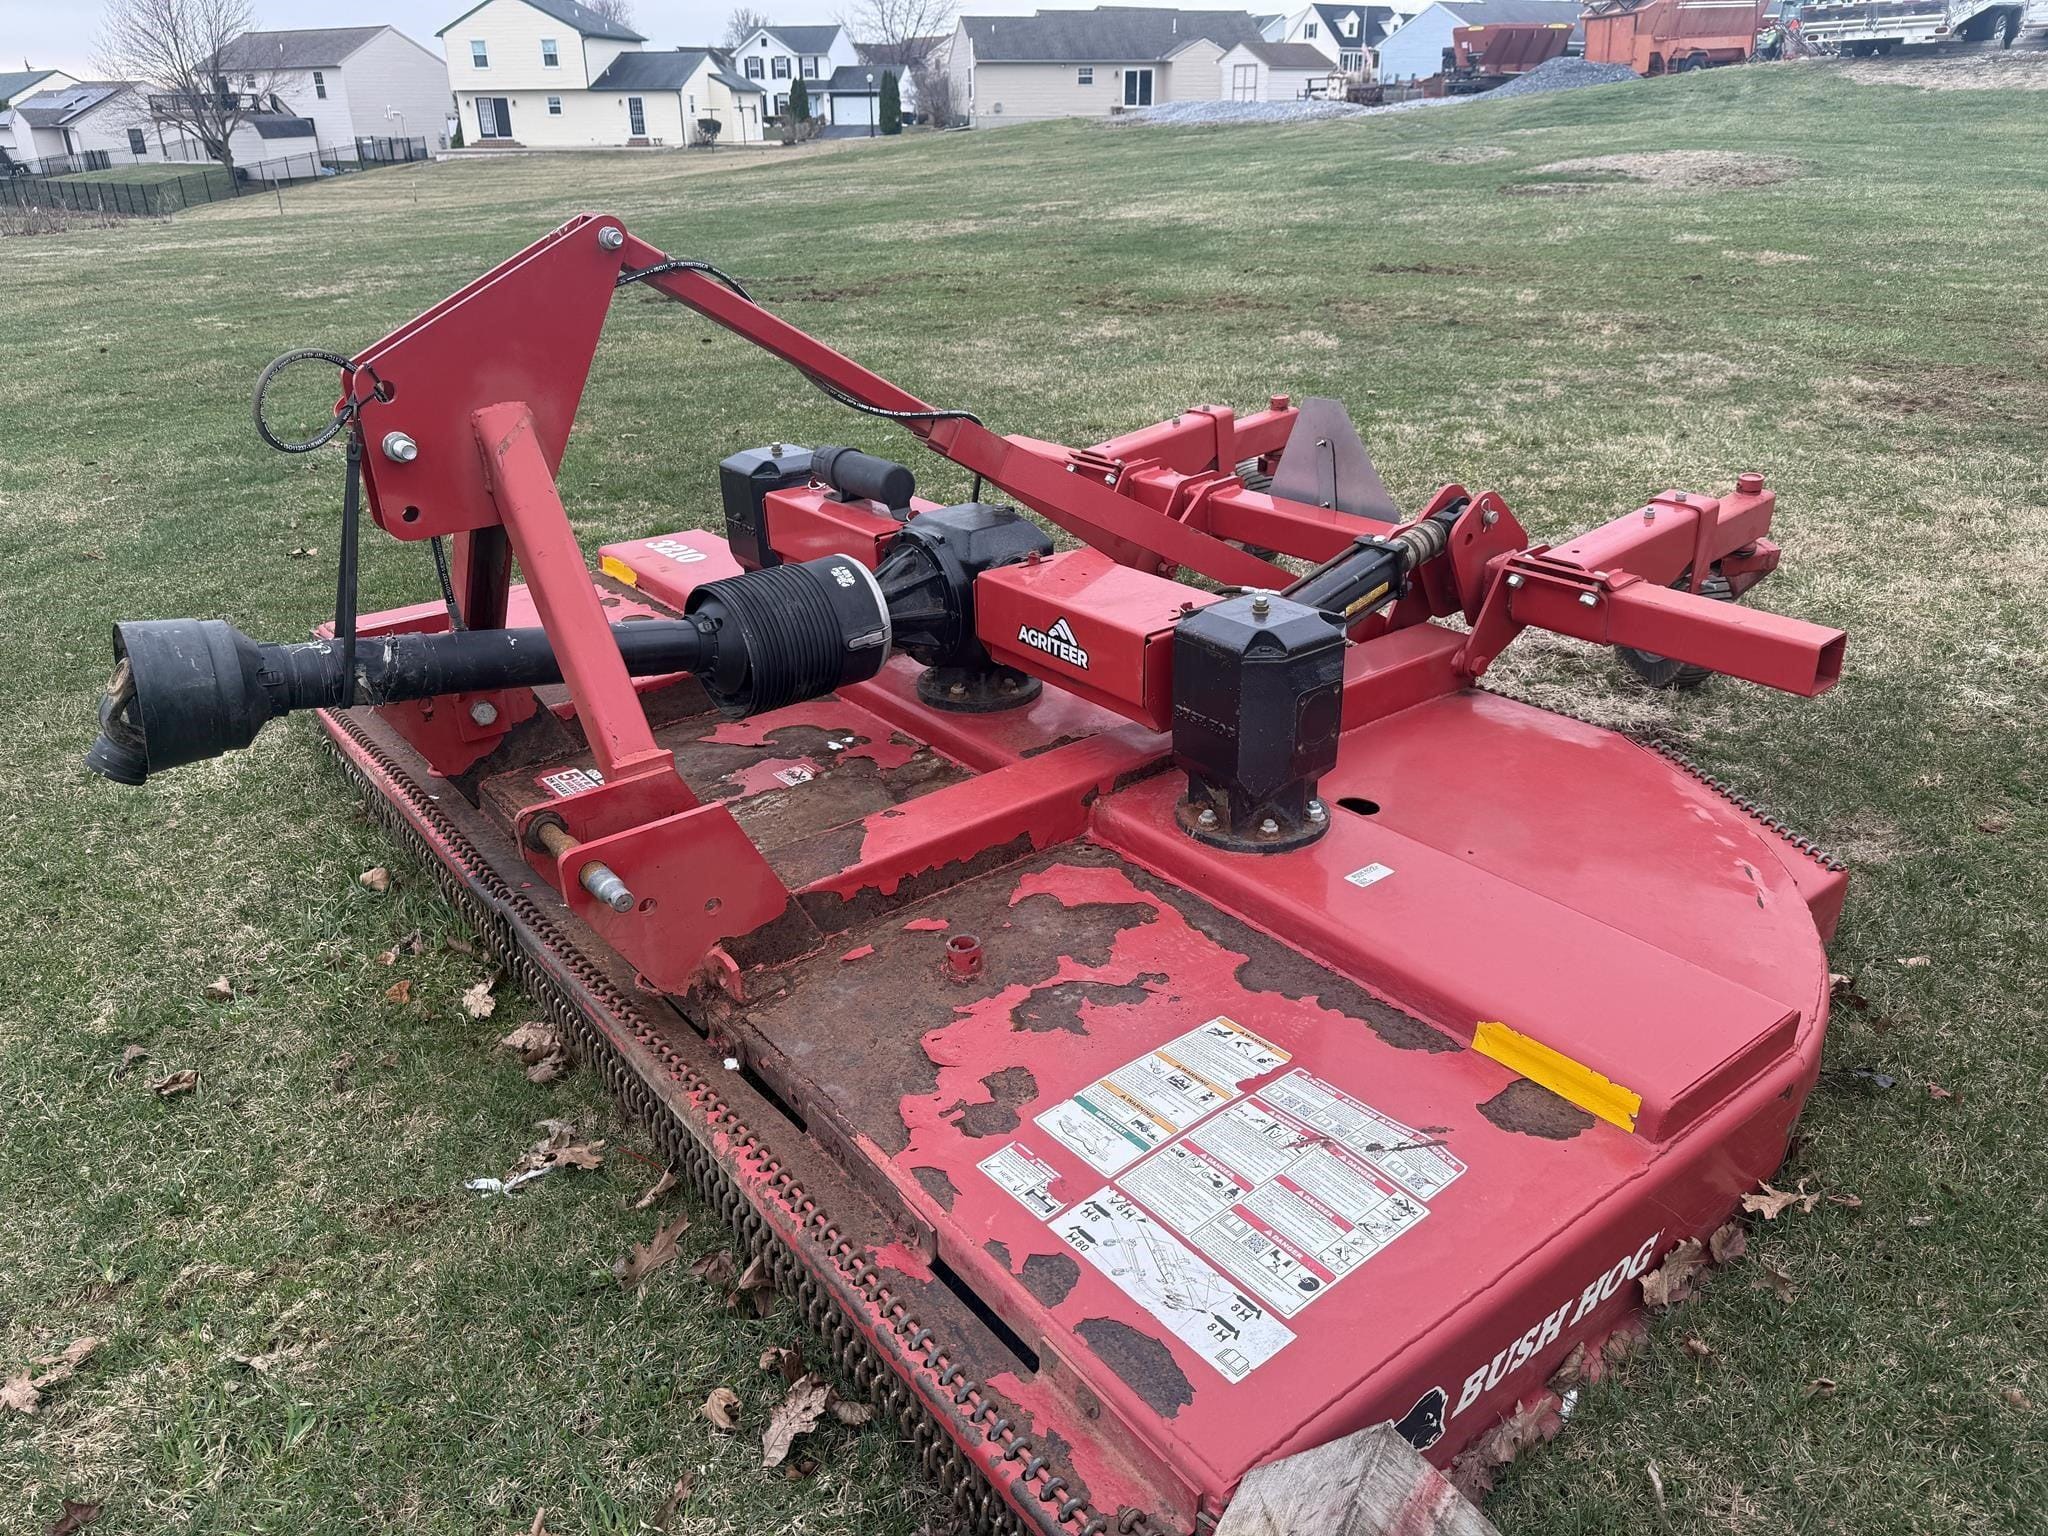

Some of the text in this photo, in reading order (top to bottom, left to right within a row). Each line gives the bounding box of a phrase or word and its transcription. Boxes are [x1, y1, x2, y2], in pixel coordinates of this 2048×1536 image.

[644, 539, 708, 563] 3210
[1018, 625, 1089, 669] AGRITEER
[1245, 1032, 1273, 1050] WARNING
[1181, 1066, 1209, 1086] WARNING
[1126, 1096, 1155, 1119] WARNING
[1350, 1099, 1379, 1118] DANGER
[1094, 1110, 1129, 1135] IMPORTANT
[1275, 1113, 1304, 1131] DANGER
[1385, 1118, 1414, 1138] PERIGO
[998, 1170, 1015, 1183] HERE
[1205, 1155, 1235, 1179] DANGER
[1347, 1157, 1379, 1183] DANGER
[1302, 1192, 1335, 1218] DANGER
[1090, 1213, 1101, 1223] 8
[1074, 1238, 1090, 1252] 80
[1271, 1232, 1304, 1258] DANGER
[1230, 1303, 1241, 1312] 8
[1206, 1322, 1218, 1332] 8
[1451, 1231, 1660, 1420] BUSH HOG
